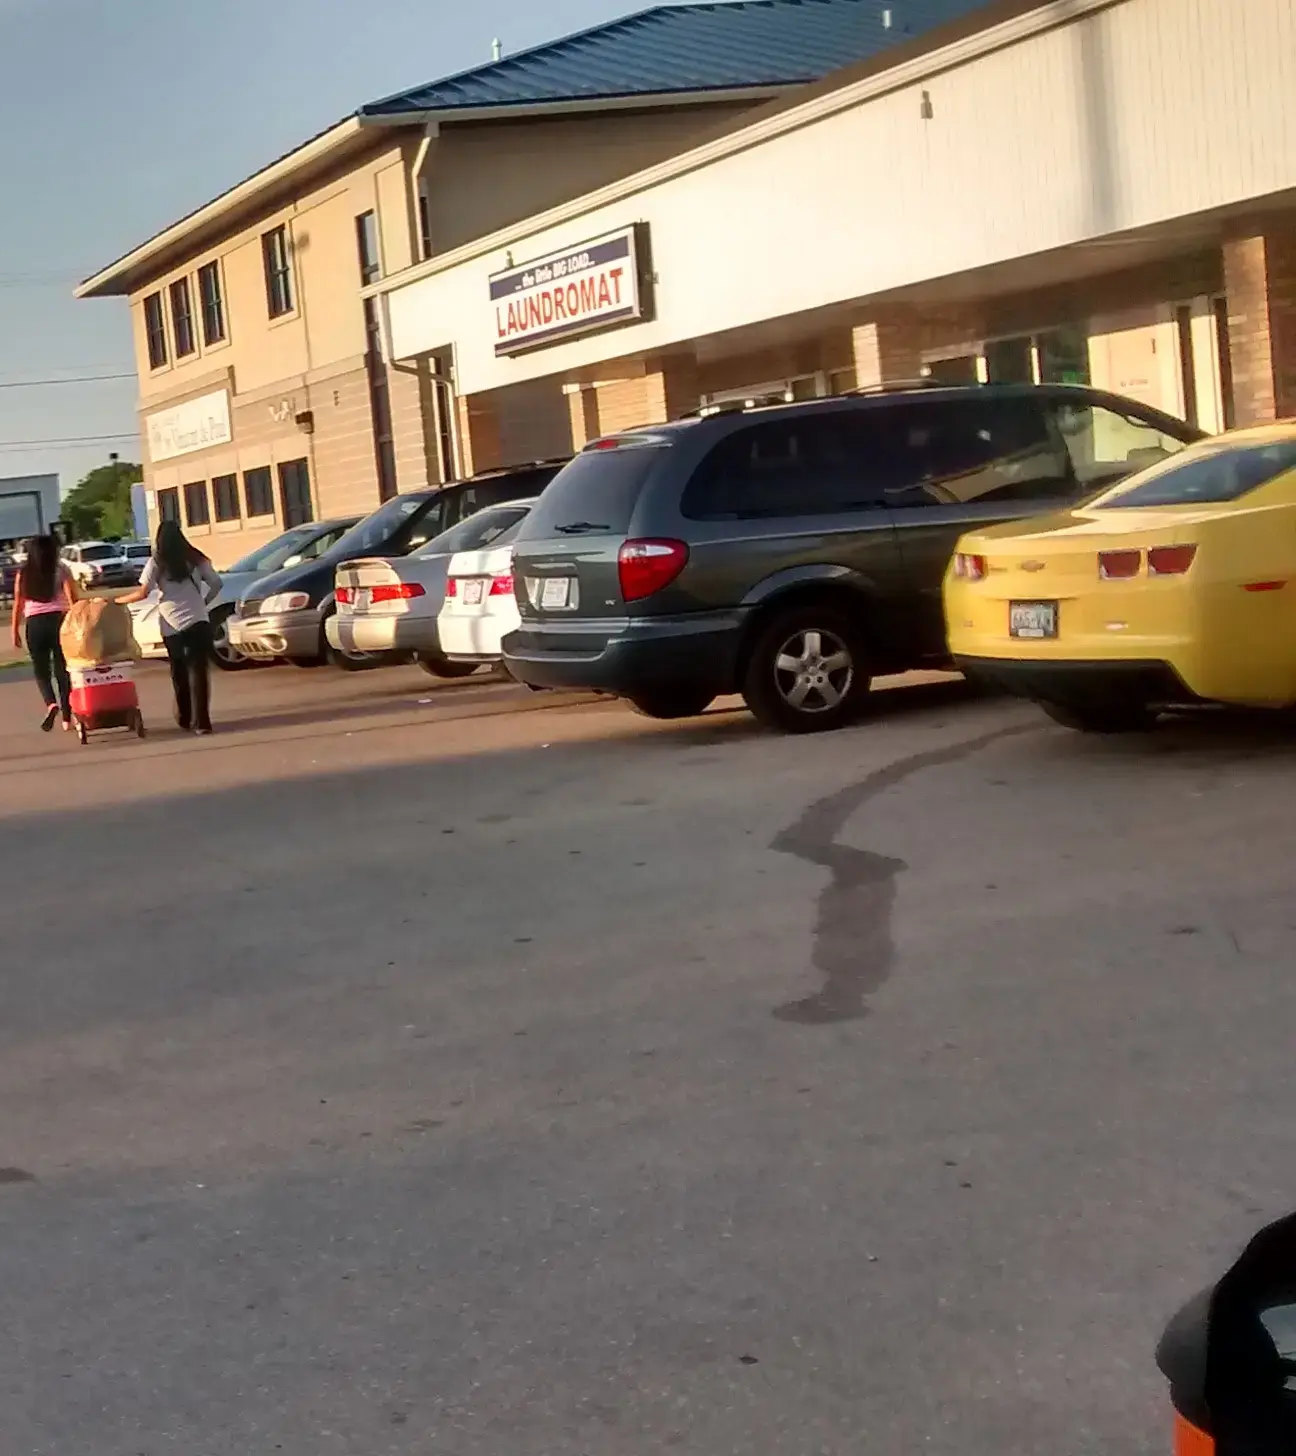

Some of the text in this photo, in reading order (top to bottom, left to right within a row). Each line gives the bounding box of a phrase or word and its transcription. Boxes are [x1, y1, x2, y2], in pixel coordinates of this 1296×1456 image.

[535, 266, 552, 284] little
[553, 261, 567, 277] BIG
[496, 267, 623, 338] LAUNDROMAT
